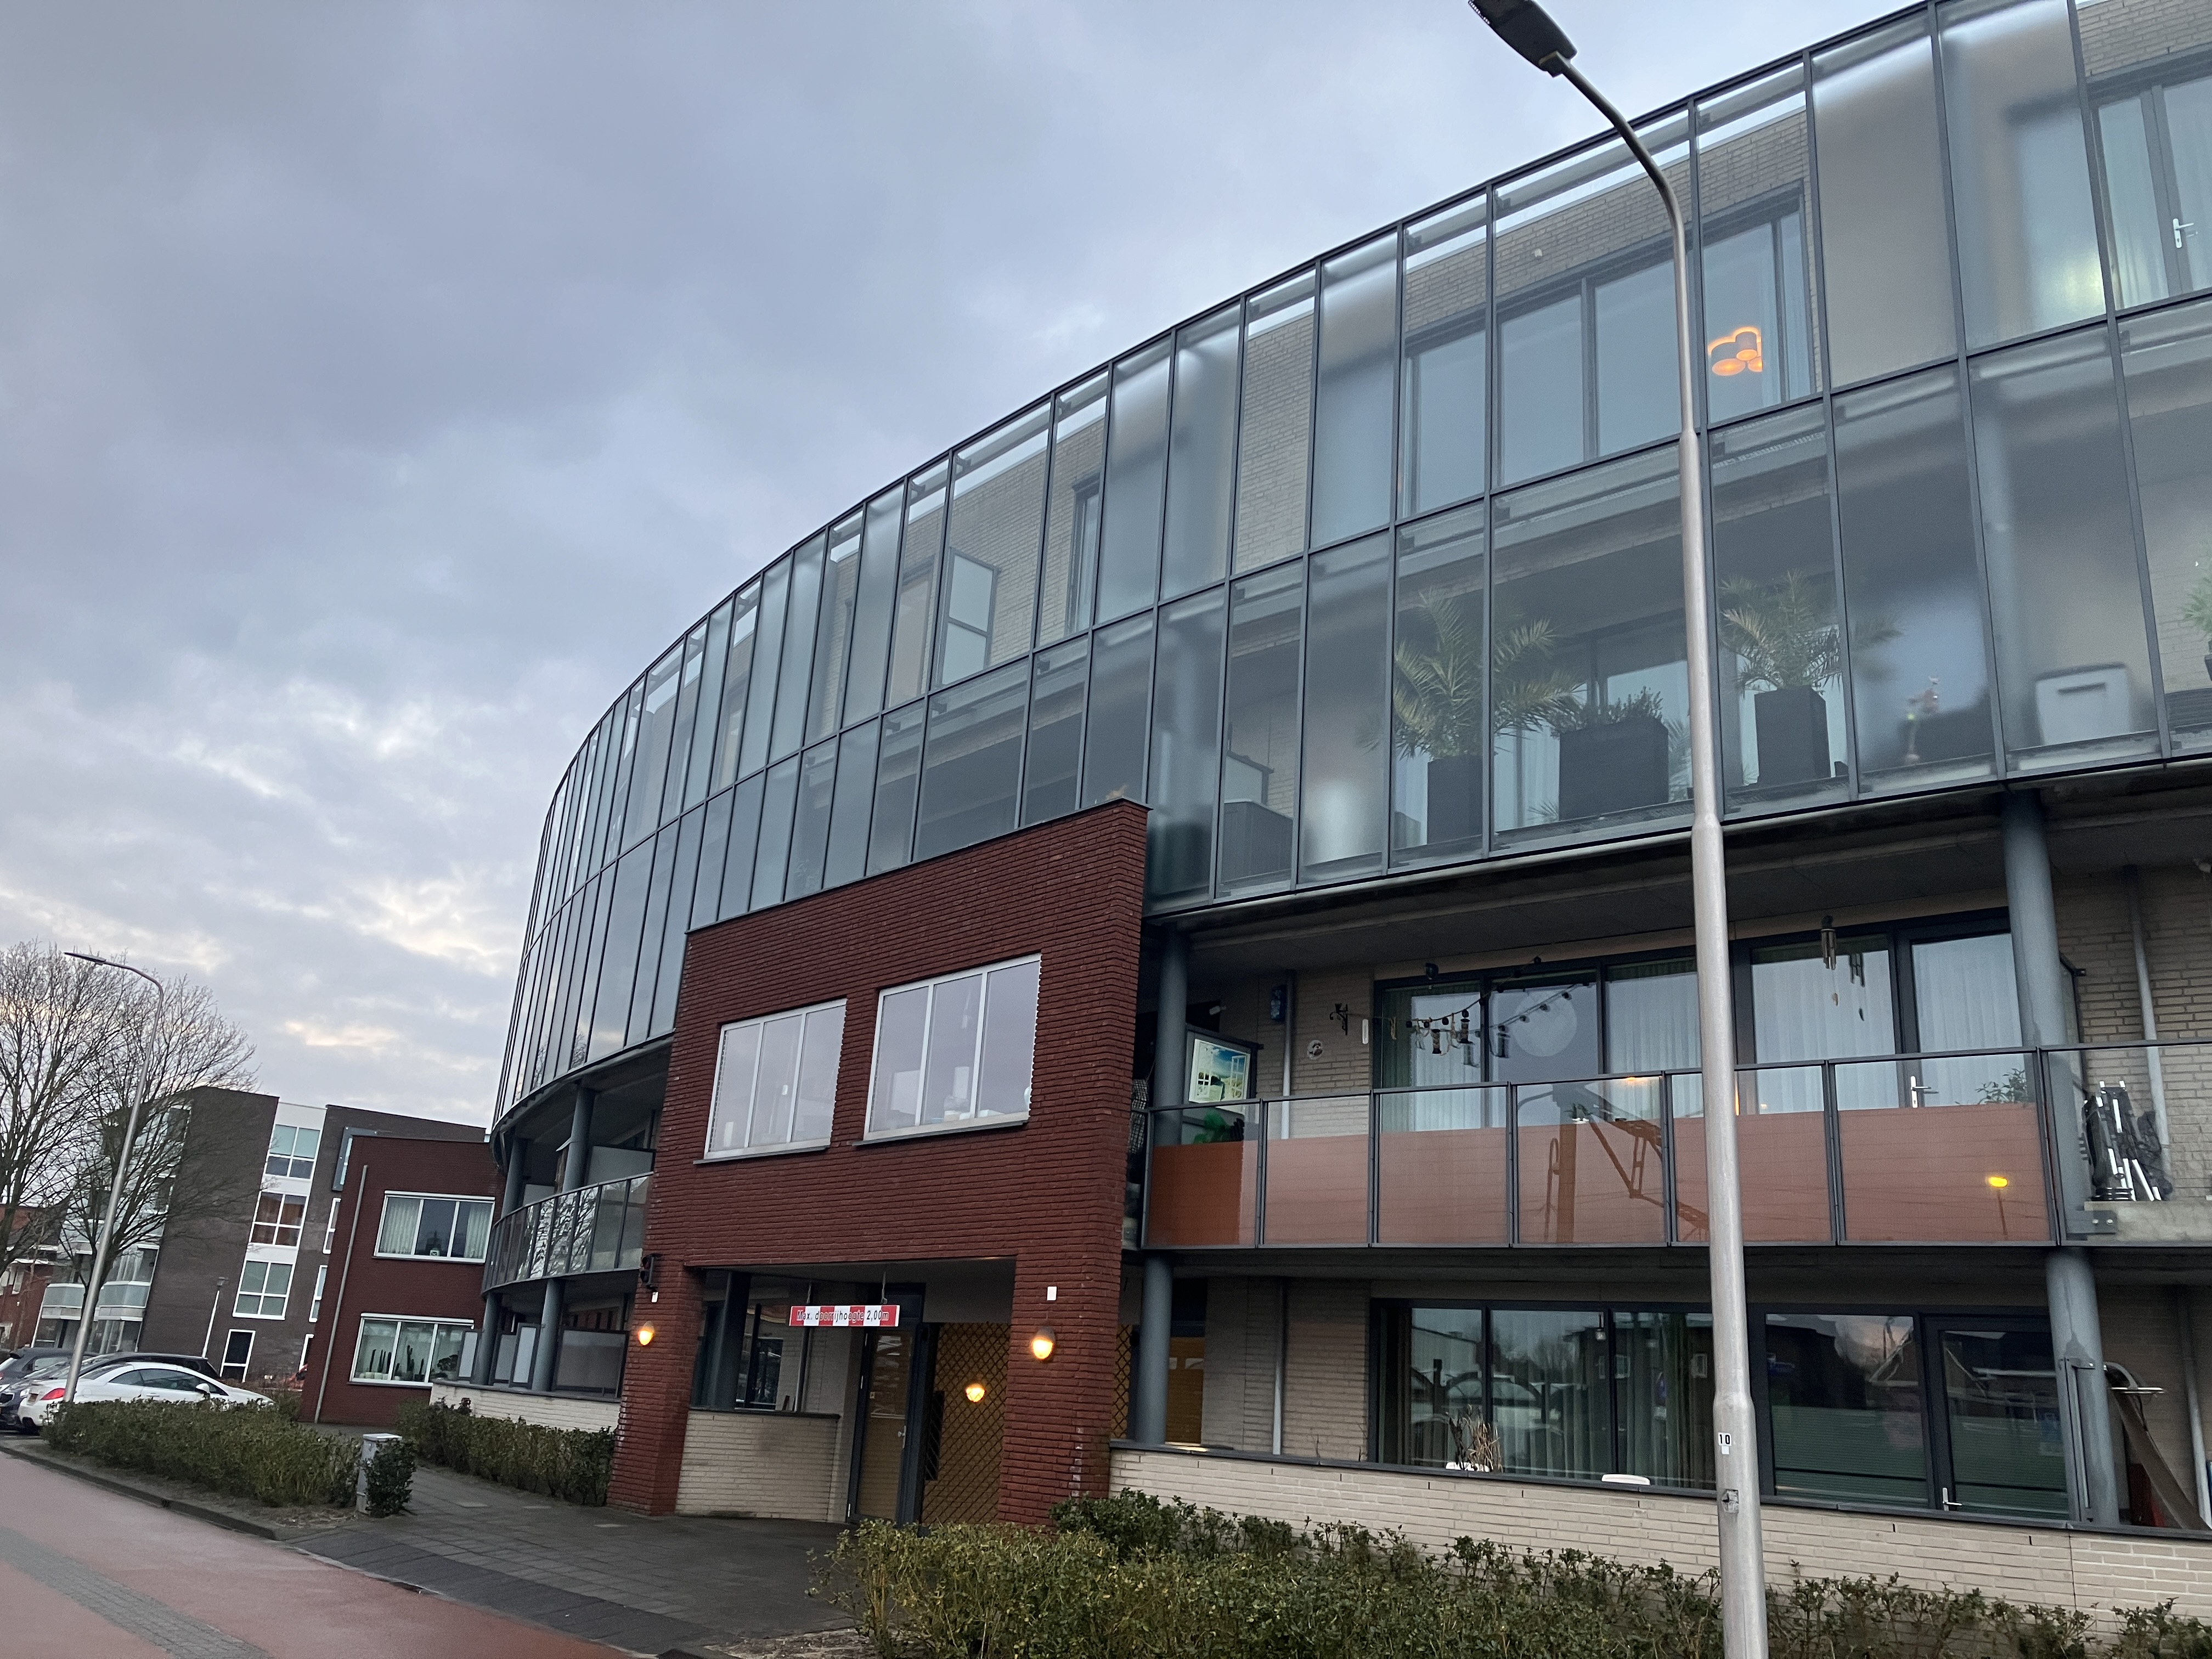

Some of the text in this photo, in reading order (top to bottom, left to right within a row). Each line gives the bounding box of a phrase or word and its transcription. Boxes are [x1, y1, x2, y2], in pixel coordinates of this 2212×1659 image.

[797, 1310, 889, 1323] Max. doorrijhoogte 2,00m
[1719, 1434, 1730, 1444] 10
